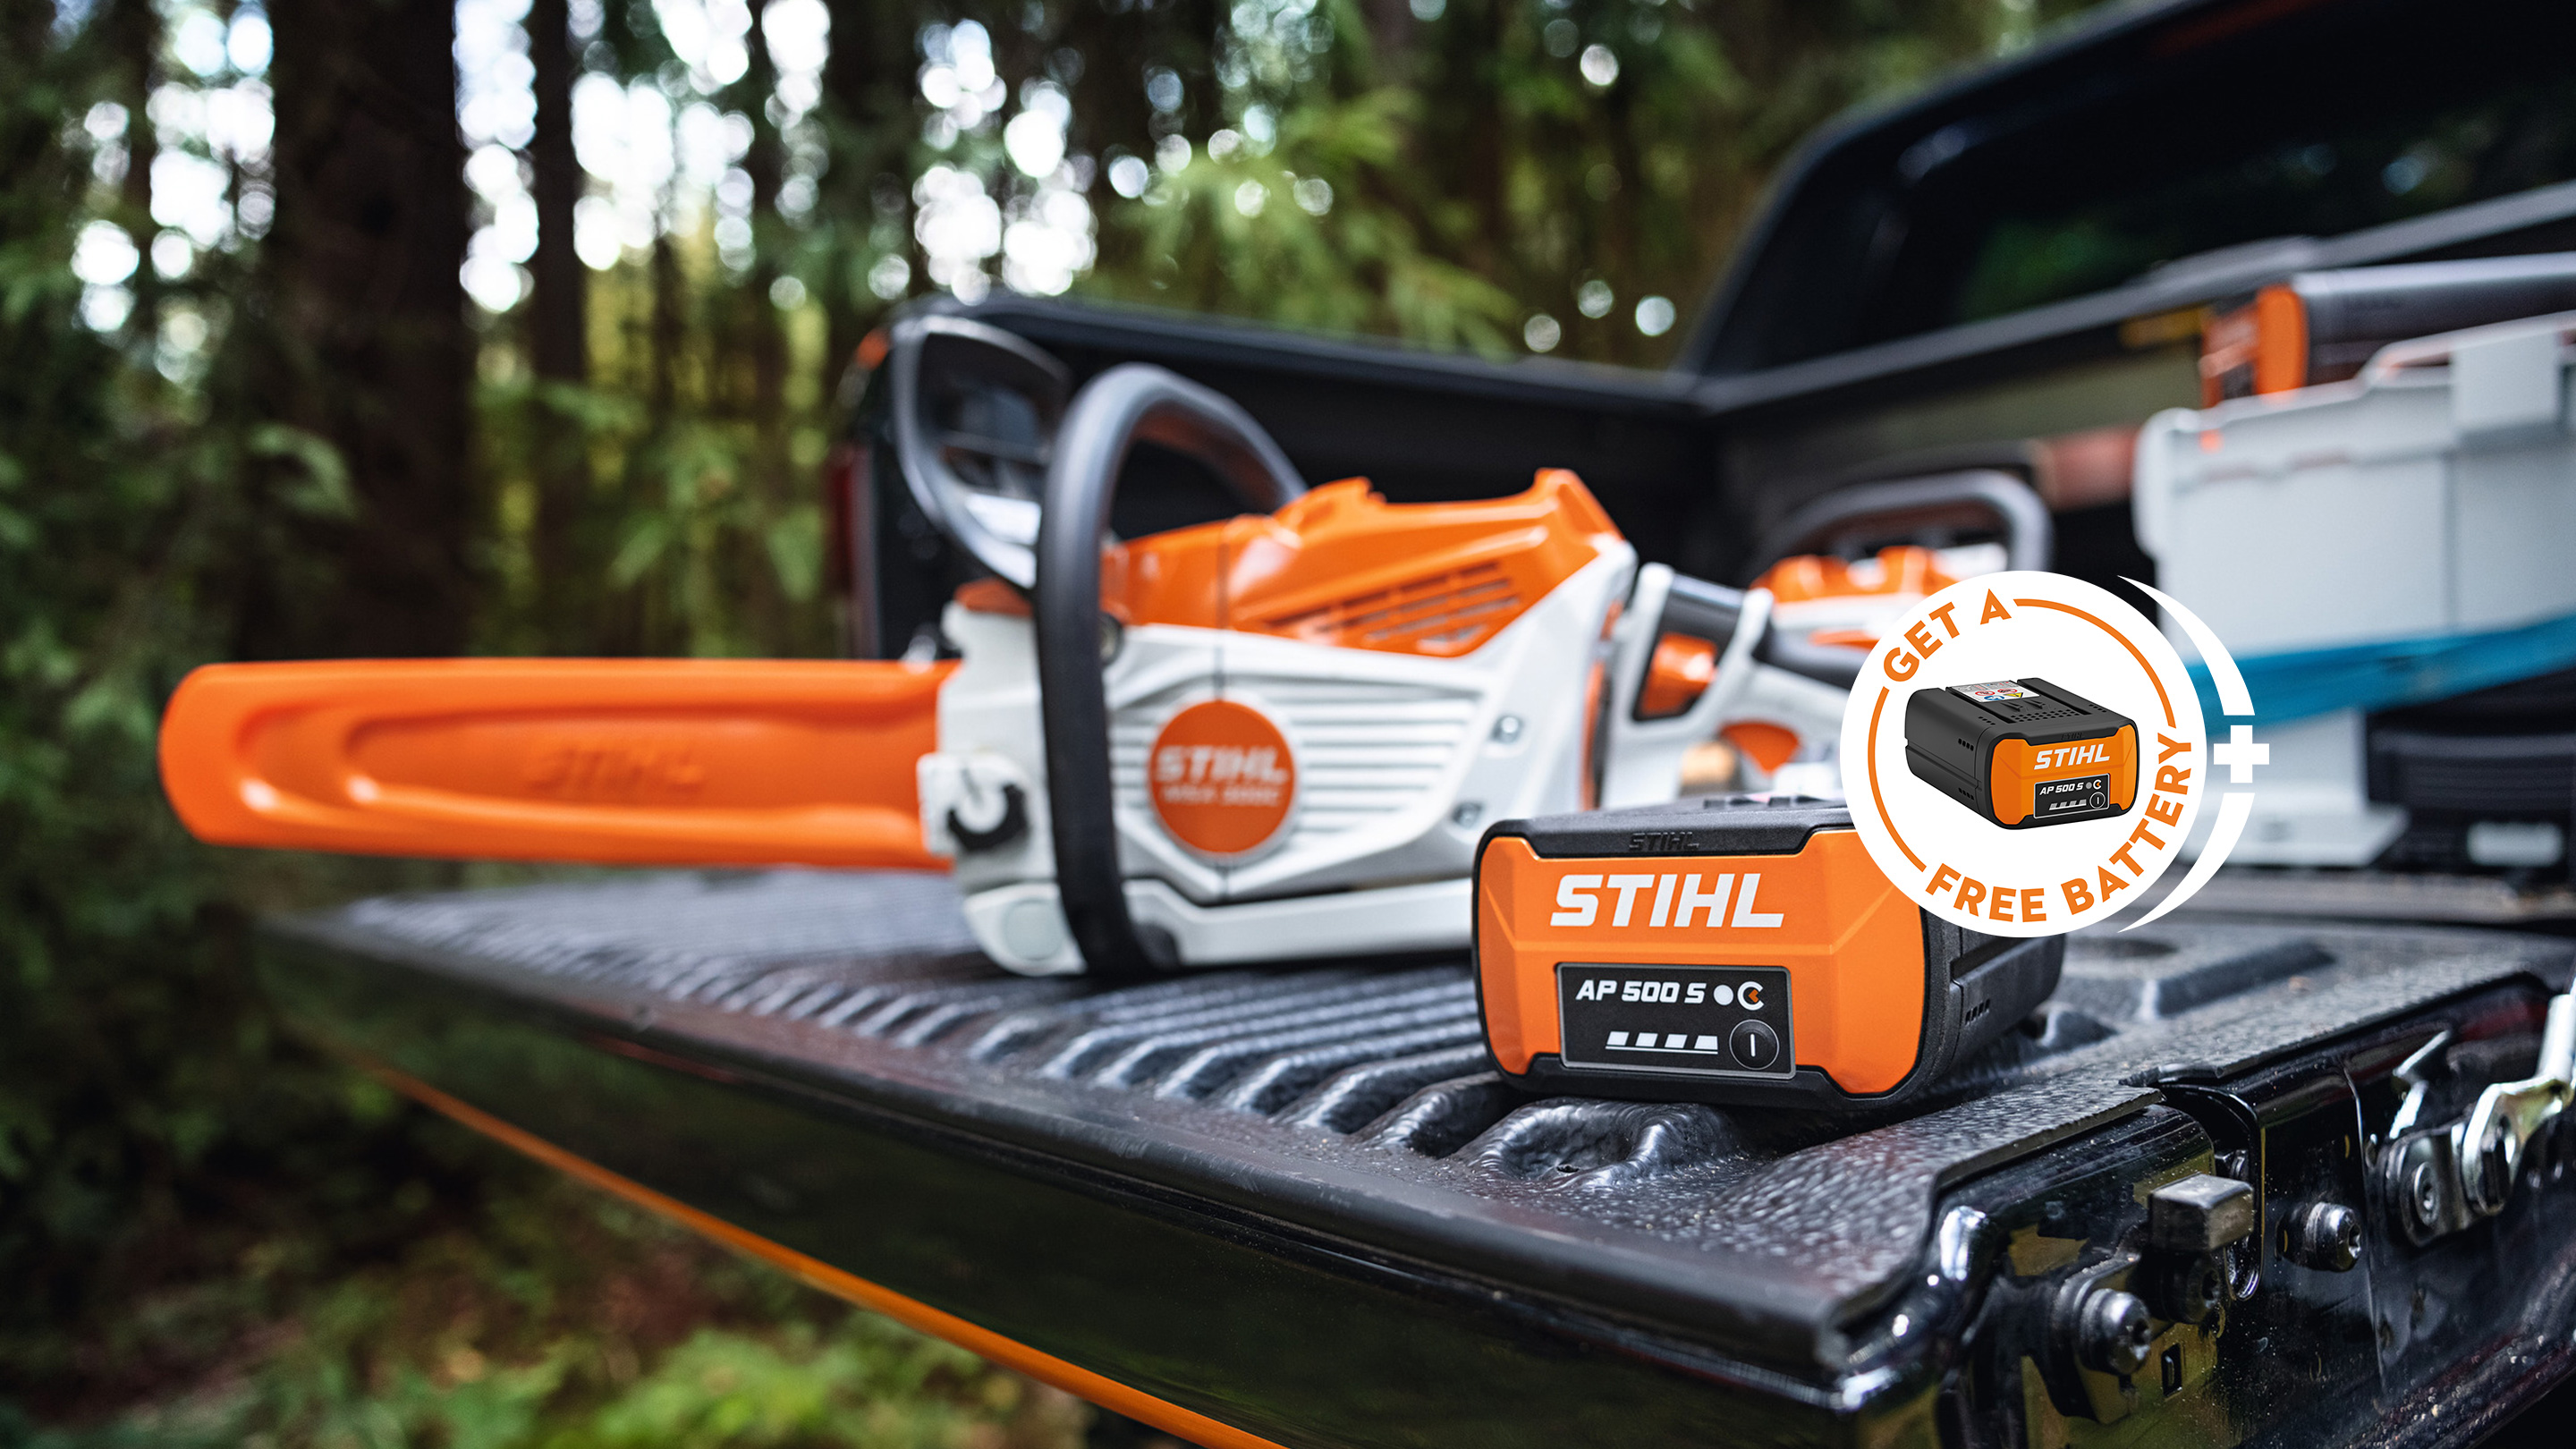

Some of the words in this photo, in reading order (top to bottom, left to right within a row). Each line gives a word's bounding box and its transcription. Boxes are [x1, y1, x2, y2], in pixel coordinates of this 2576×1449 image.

[1157, 744, 1289, 784] STIHL
[1629, 831, 1700, 850] STIHL
[1550, 873, 1784, 928] STIHL
[1575, 979, 1617, 1001] AP
[1621, 980, 1681, 1004] 500
[1684, 982, 1707, 1004] S
